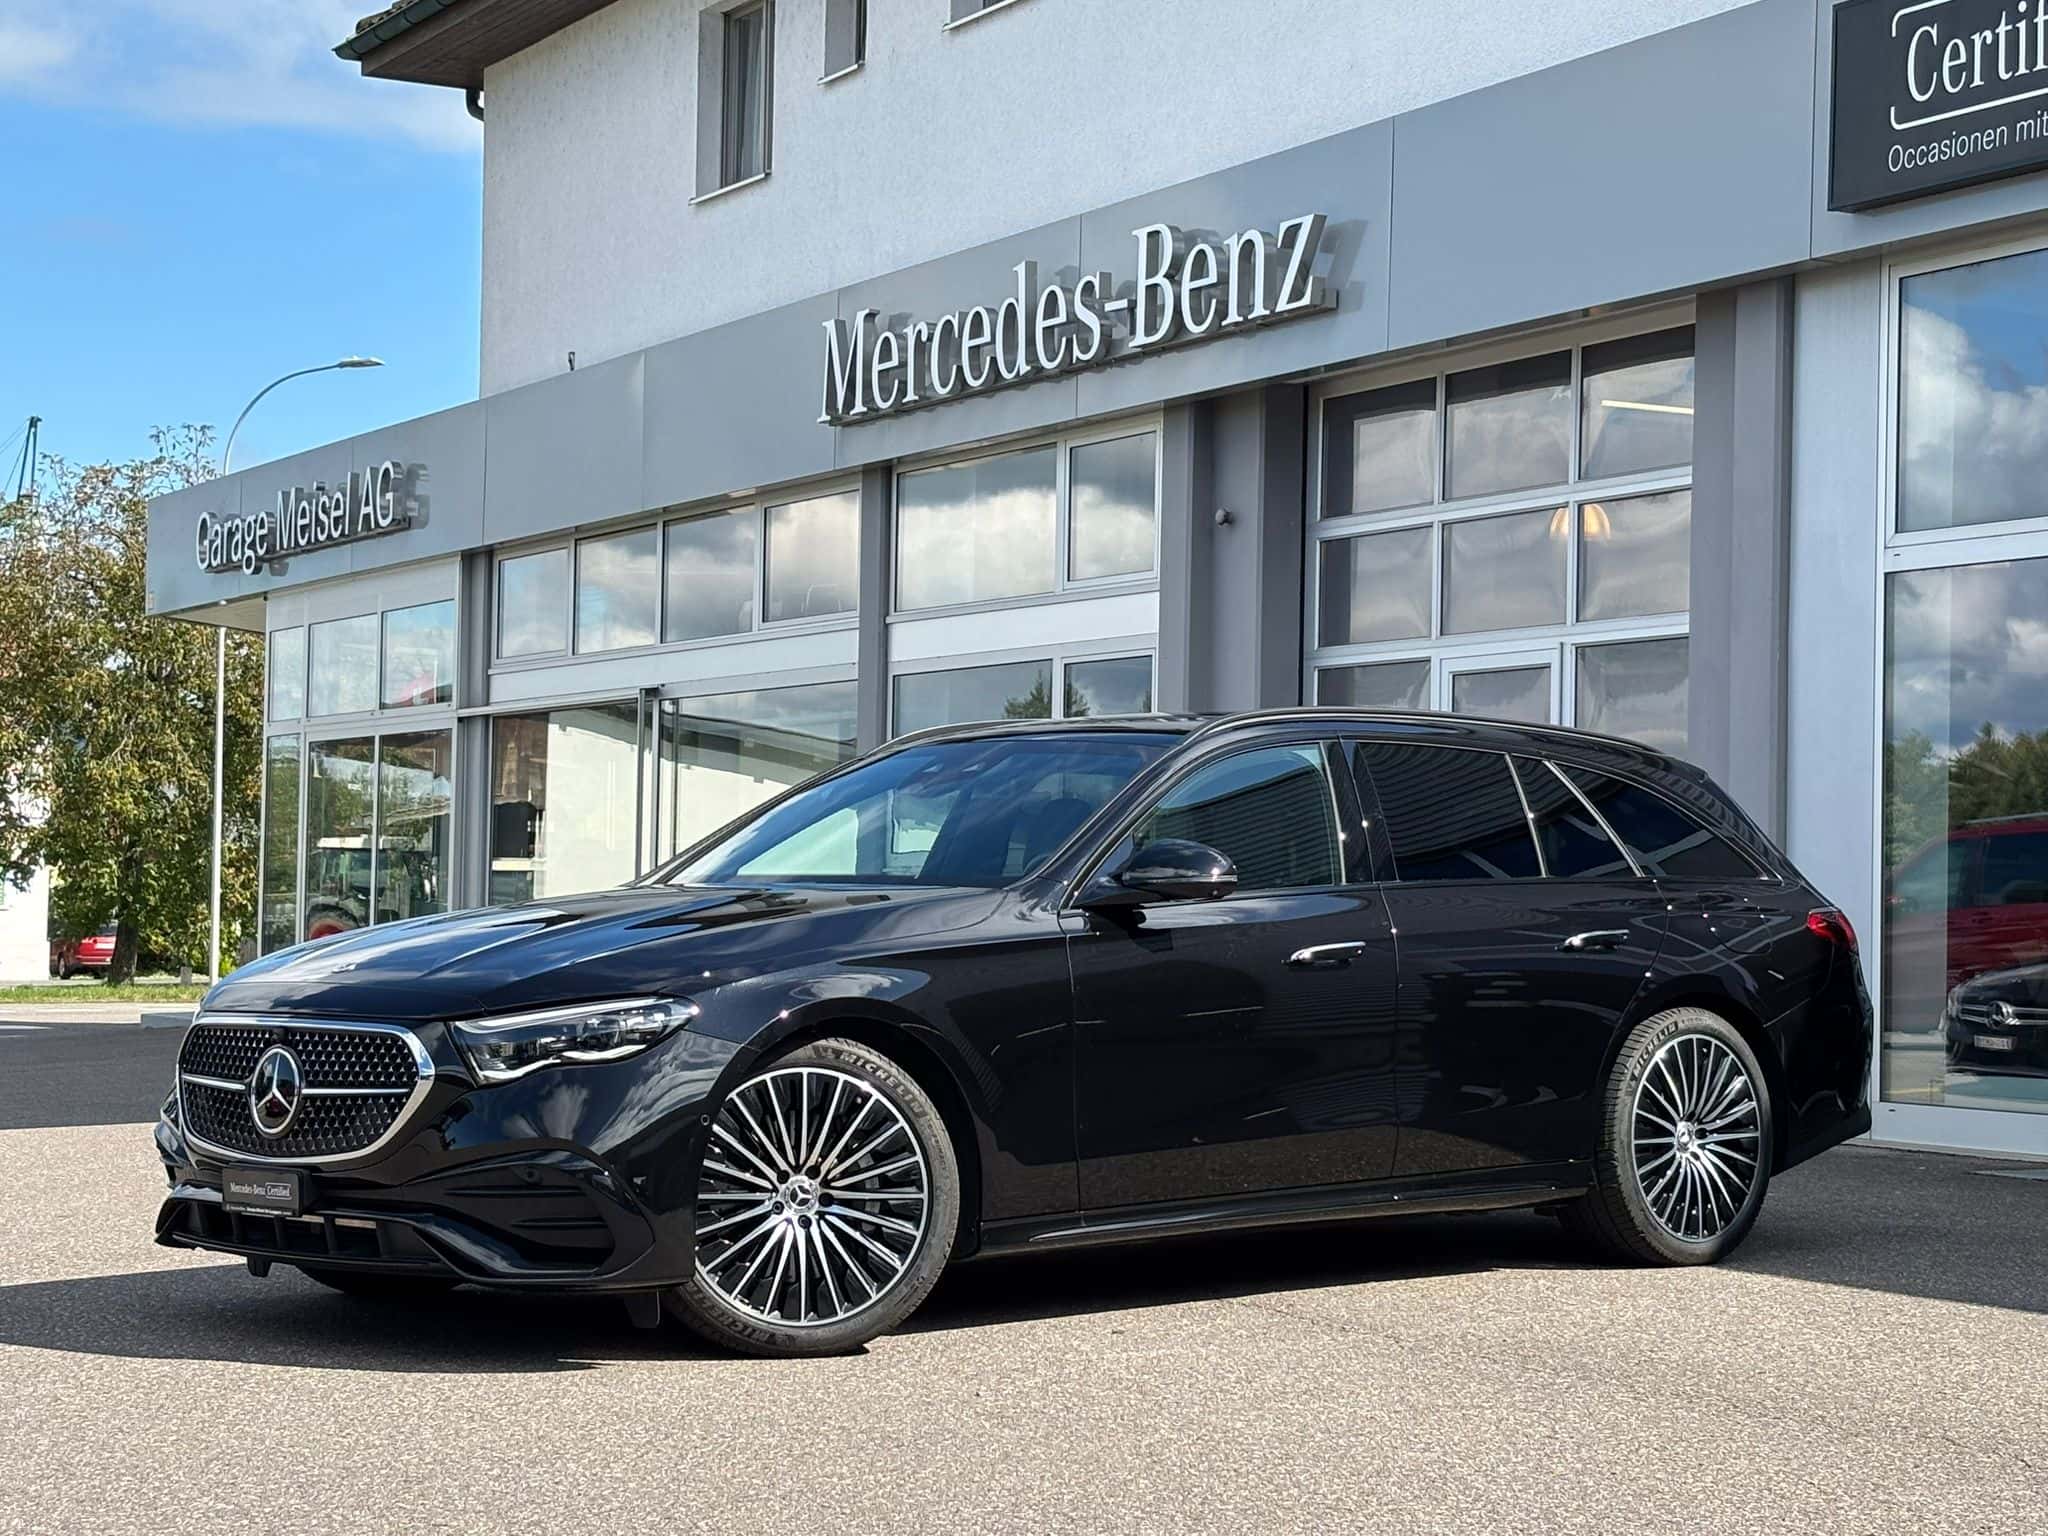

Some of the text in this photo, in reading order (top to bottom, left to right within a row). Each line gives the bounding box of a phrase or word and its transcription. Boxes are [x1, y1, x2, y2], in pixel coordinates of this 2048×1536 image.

[1888, 110, 2048, 173] Occasionen mit
[817, 213, 1327, 425] Mercedes-Benz
[196, 460, 399, 576] Garage Meisel AG
[1632, 1022, 1677, 1079] MICHELIN
[840, 1051, 925, 1114] MICHELIN
